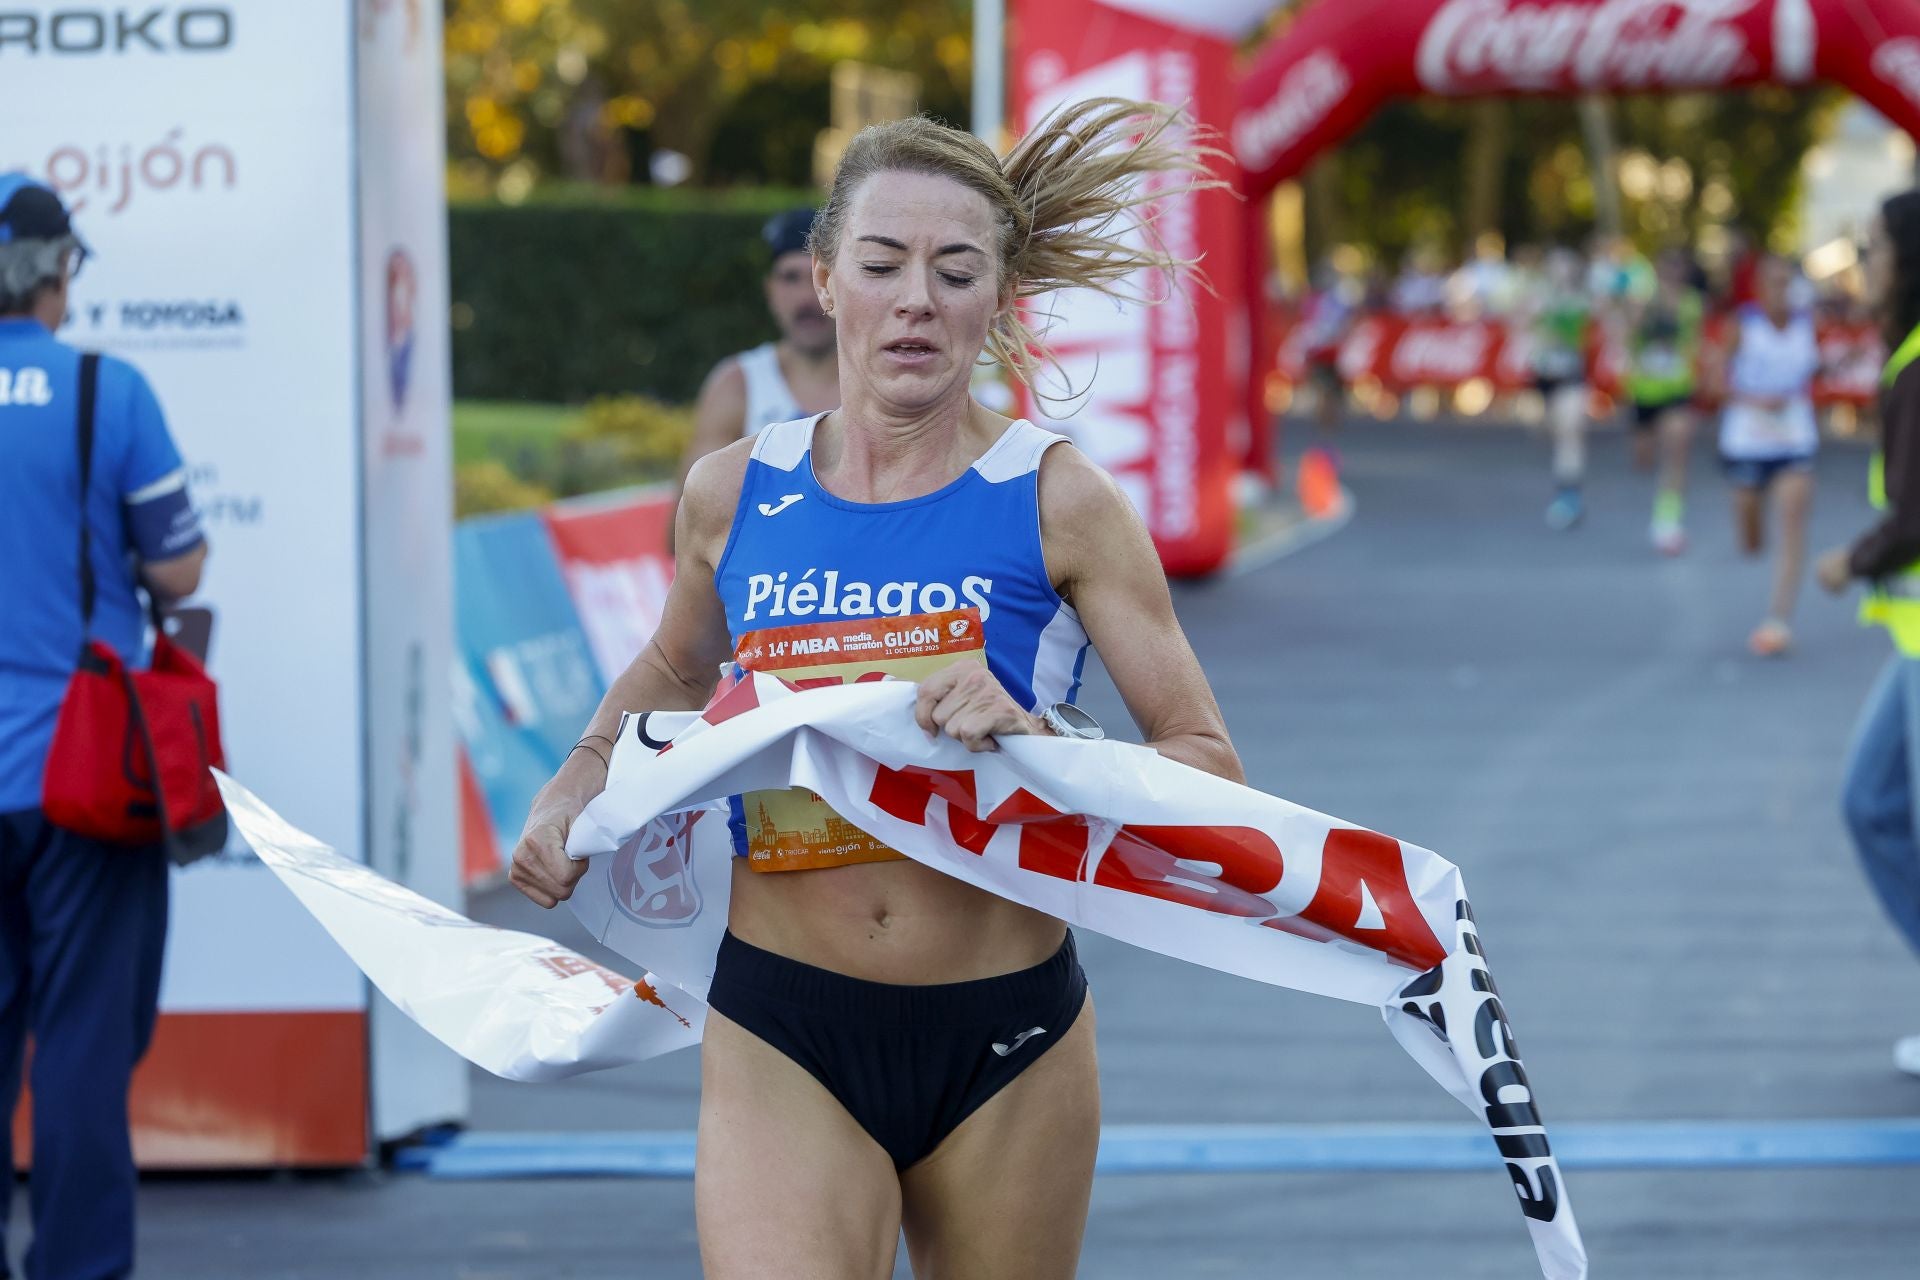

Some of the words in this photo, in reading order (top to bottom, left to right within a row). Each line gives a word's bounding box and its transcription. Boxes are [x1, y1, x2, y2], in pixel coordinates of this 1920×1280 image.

[843, 631, 872, 643] media
[884, 626, 940, 648] GIJÓN
[791, 636, 841, 656] MBA
[843, 640, 883, 652] maratón
[885, 648, 893, 656] 11
[894, 646, 923, 655] OCTUBRE
[925, 644, 940, 652] 2025
[868, 763, 1449, 973] MBA
